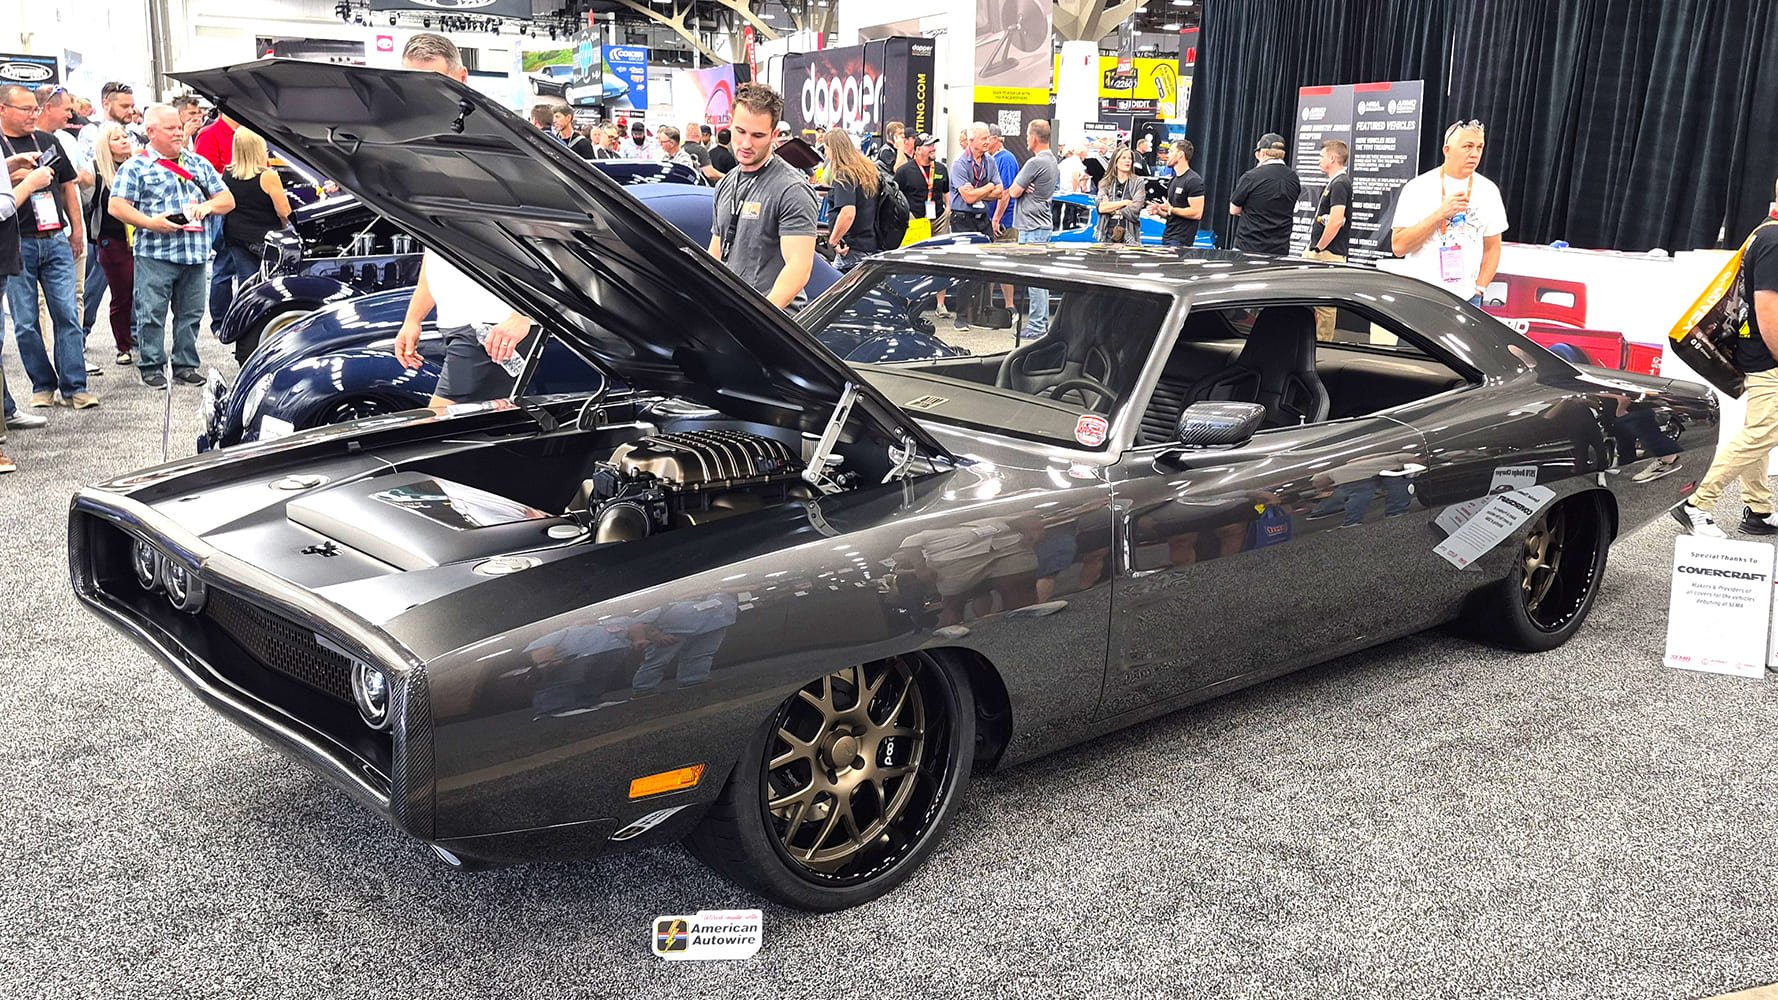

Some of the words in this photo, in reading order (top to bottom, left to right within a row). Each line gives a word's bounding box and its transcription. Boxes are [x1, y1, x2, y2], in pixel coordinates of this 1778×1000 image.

[1356, 121, 1386, 131] FEATURED
[1386, 120, 1417, 131] VEHICLES
[1691, 552, 1719, 560] Special
[1721, 555, 1747, 563] Thanks
[1677, 565, 1767, 581] COVERCRAFT
[1692, 582, 1711, 590] Makers
[1718, 585, 1744, 593] Providers
[1696, 599, 1721, 607] debuting
[1732, 594, 1755, 602] vehicles
[690, 923, 758, 933] American
[692, 935, 756, 945] Autowire
